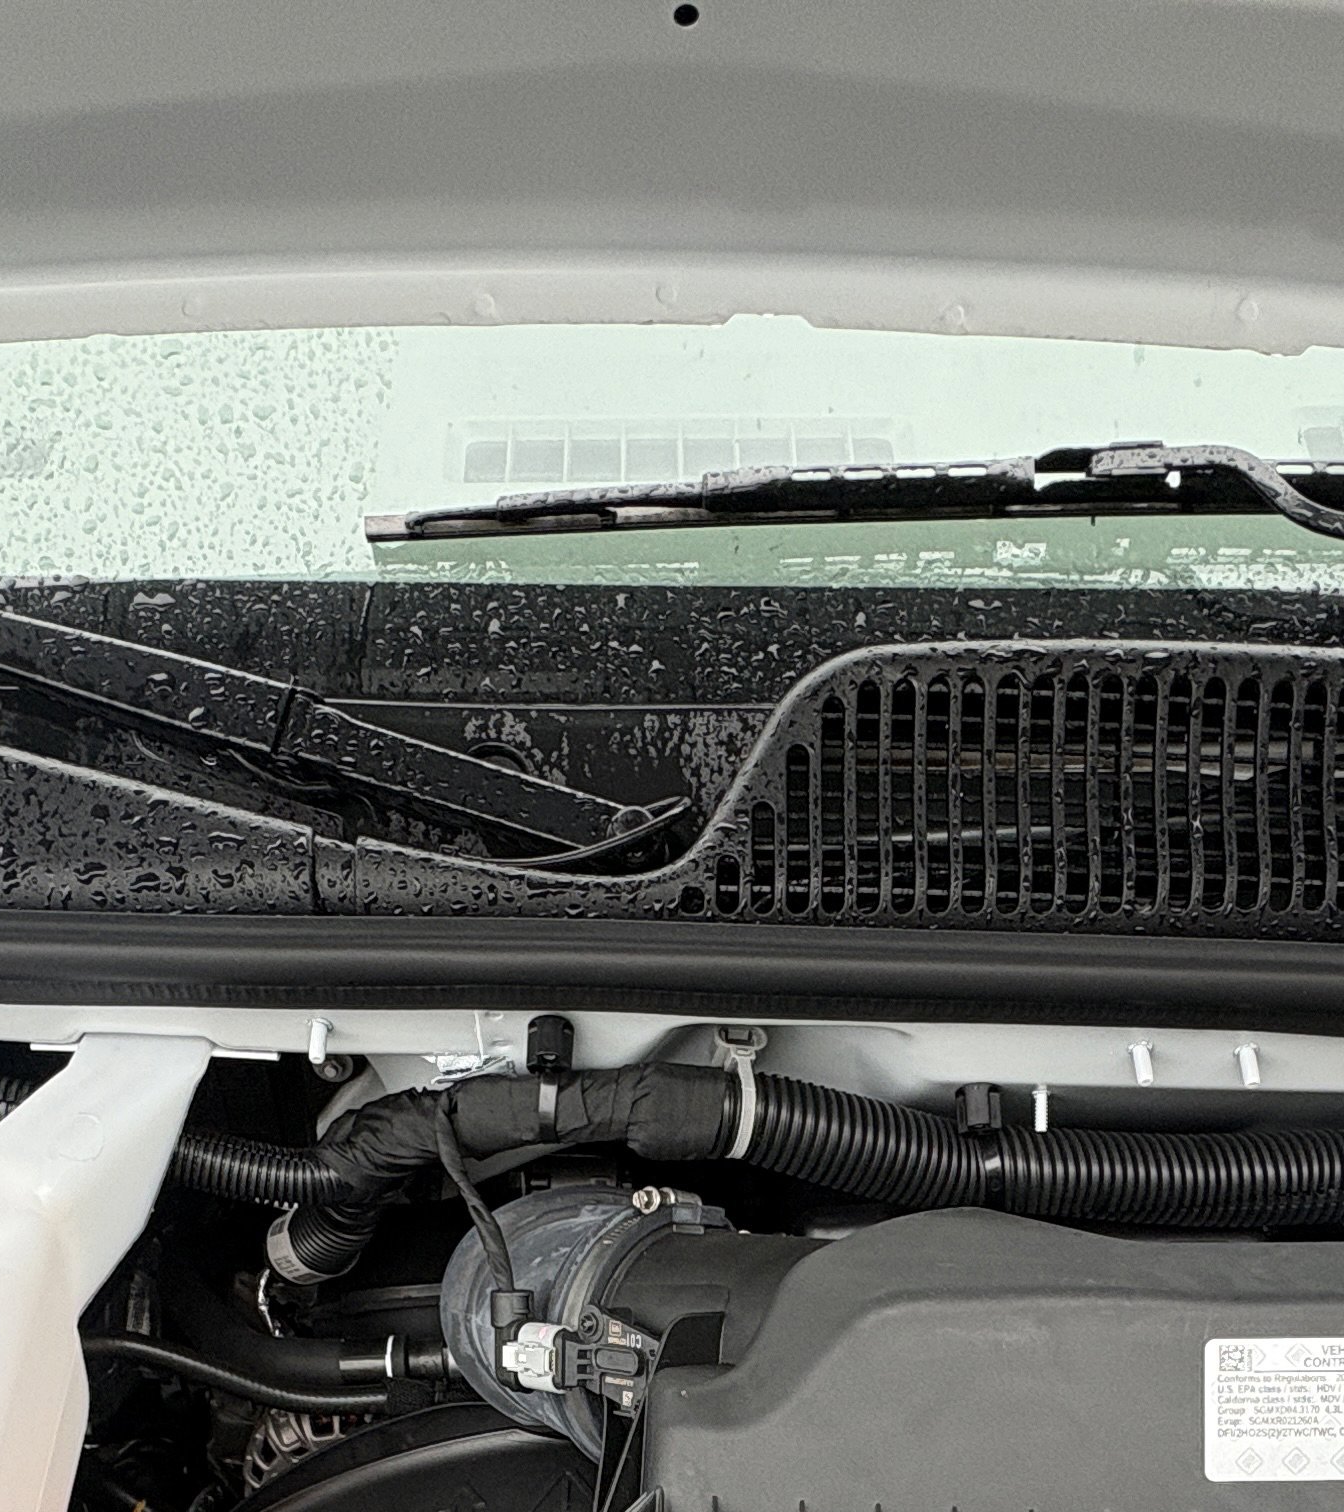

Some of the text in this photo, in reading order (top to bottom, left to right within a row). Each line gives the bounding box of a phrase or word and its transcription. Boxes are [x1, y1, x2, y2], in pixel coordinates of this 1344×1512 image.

[1217, 1375, 1260, 1383] Conforms
[1263, 1375, 1272, 1383] to
[1274, 1374, 1327, 1385] Regulations
[1238, 1385, 1256, 1394] EPA
[1258, 1385, 1281, 1393] class
[1317, 1384, 1336, 1393] HDV
[1217, 1396, 1261, 1404] California
[1262, 1395, 1286, 1404] class
